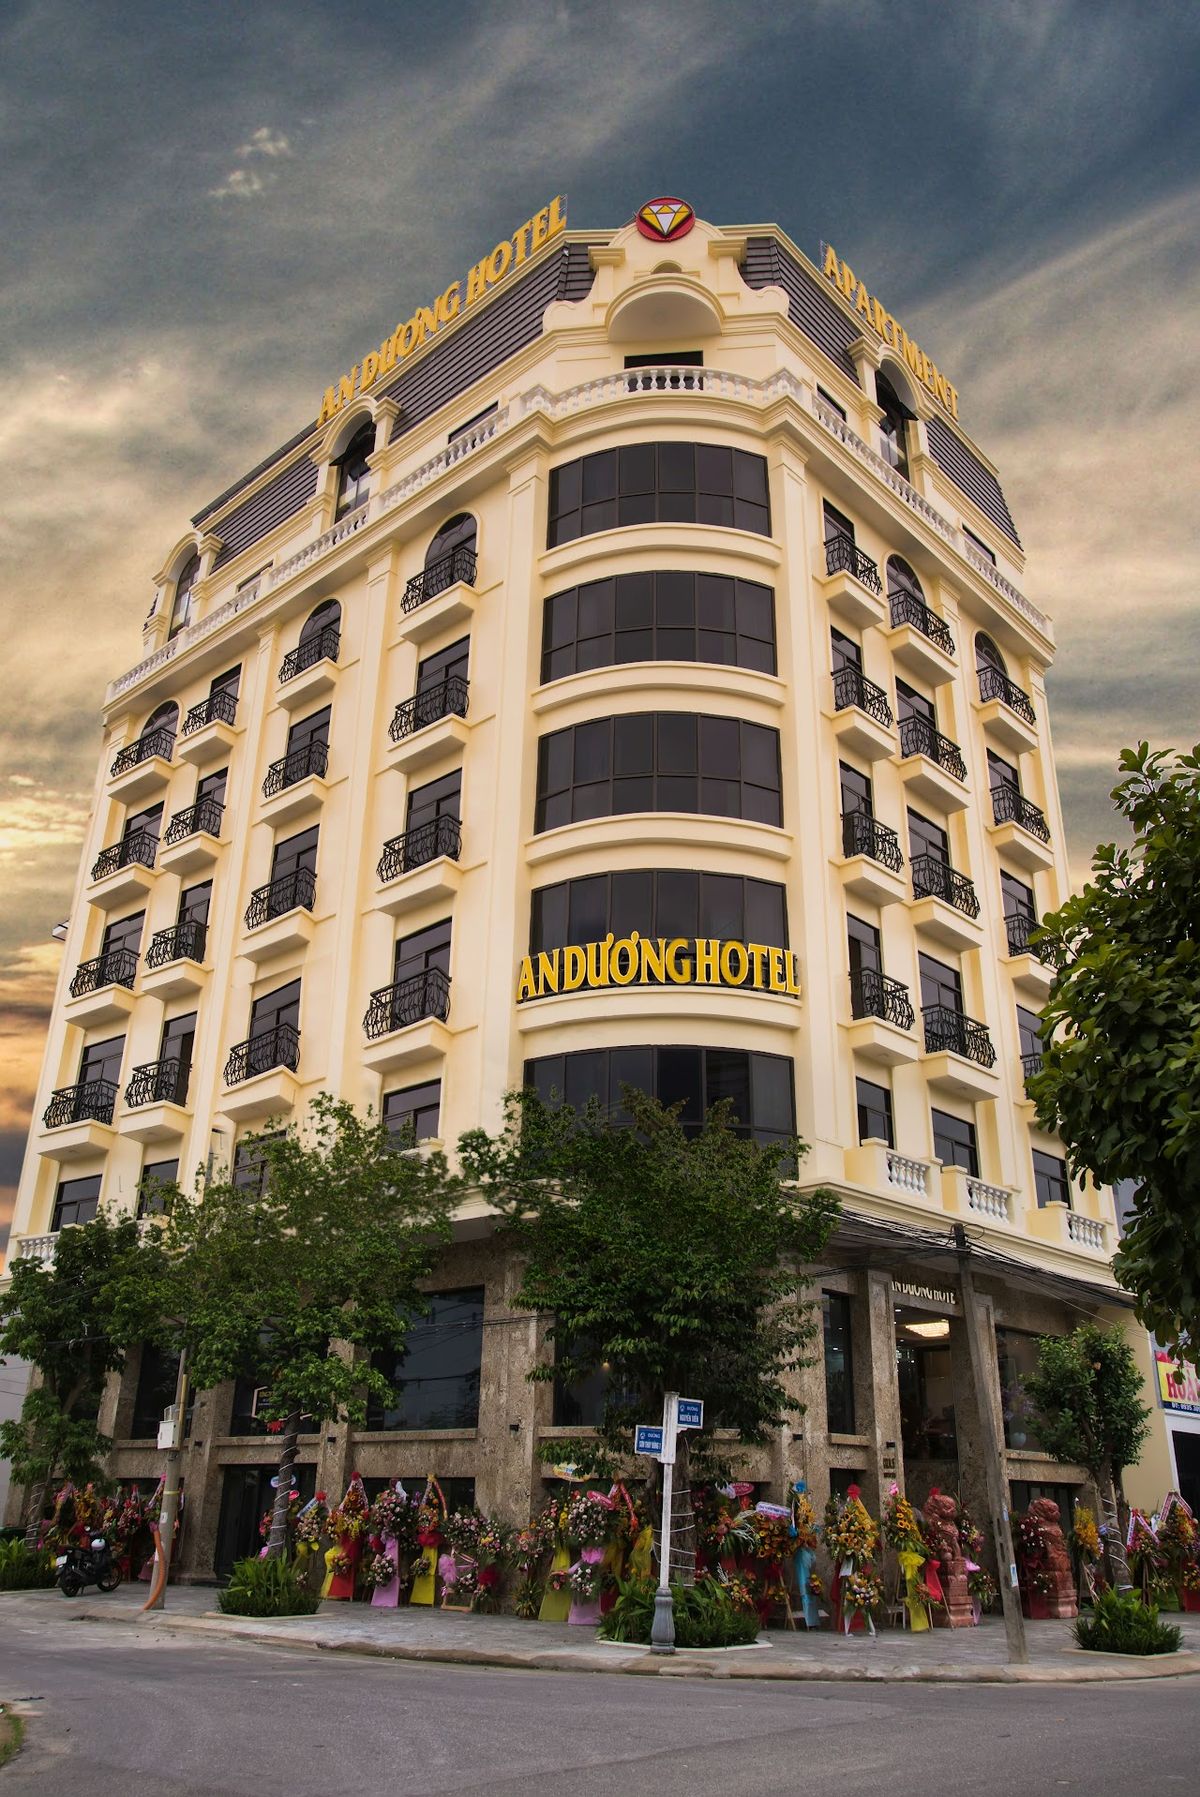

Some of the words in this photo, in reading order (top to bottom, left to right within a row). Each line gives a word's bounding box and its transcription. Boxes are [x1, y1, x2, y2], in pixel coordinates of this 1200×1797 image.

[316, 365, 358, 429] AN
[464, 195, 567, 307] HOTEL
[823, 244, 959, 422] APARTMENT
[517, 948, 559, 1001] AN
[695, 938, 802, 996] HOTEL
